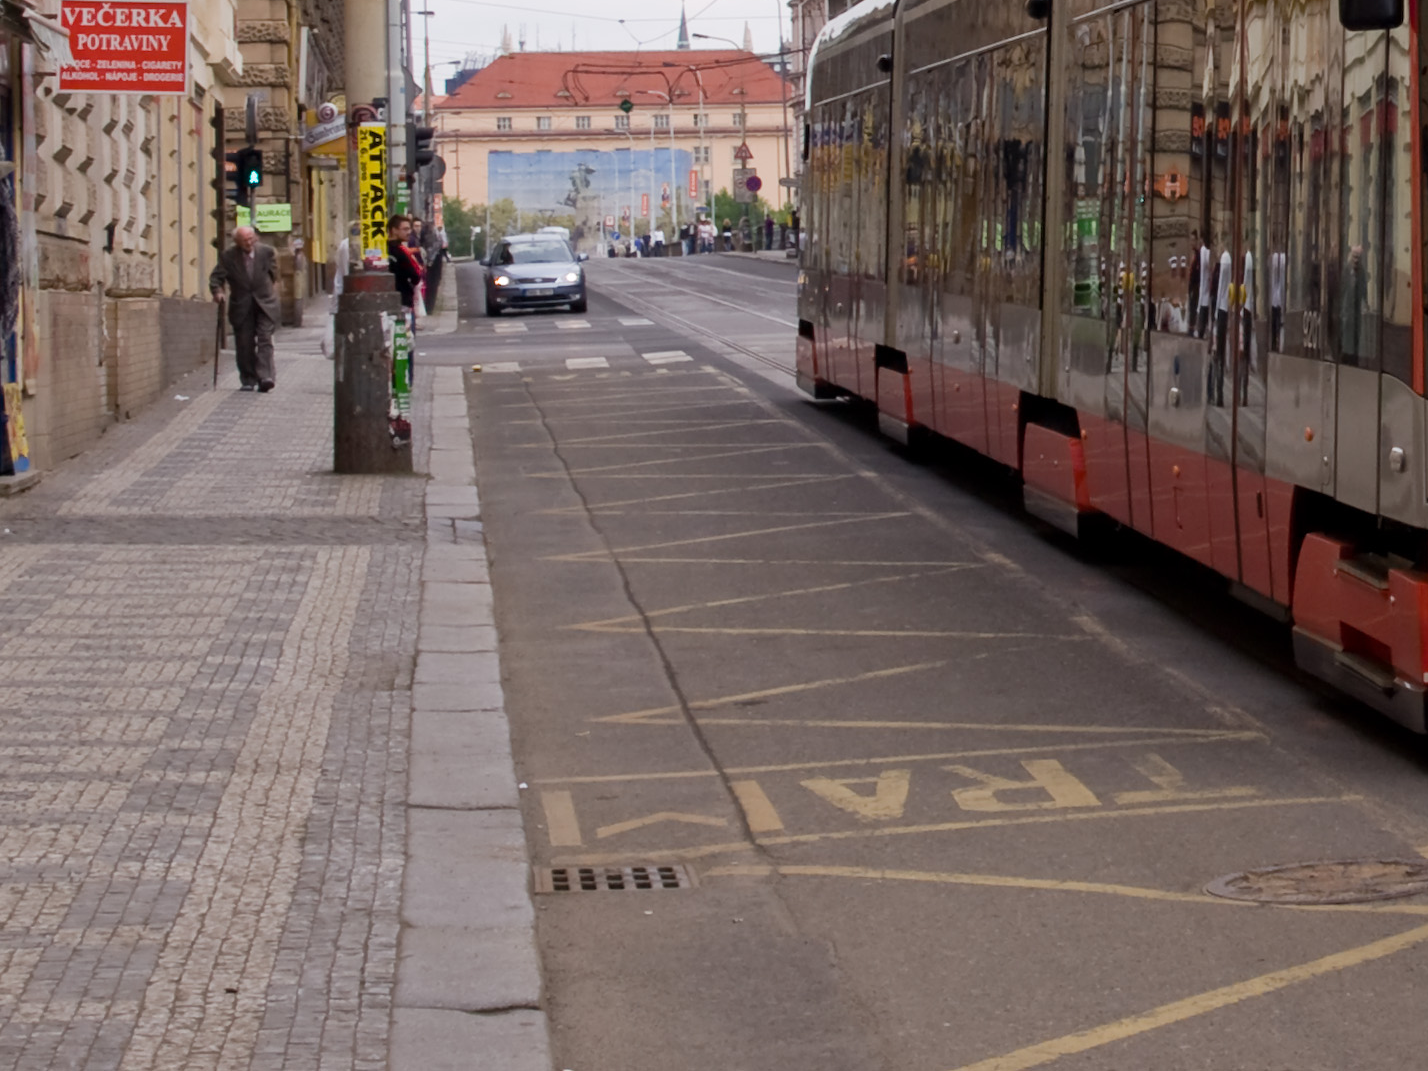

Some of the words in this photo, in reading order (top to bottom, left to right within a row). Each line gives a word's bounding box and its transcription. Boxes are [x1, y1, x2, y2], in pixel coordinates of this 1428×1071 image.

[63, 3, 184, 28] VEČERKA
[77, 34, 171, 51] POTRAVINY
[369, 130, 385, 239] ATTACK
[363, 223, 371, 250] Aren
[540, 753, 1263, 847] TRAM
